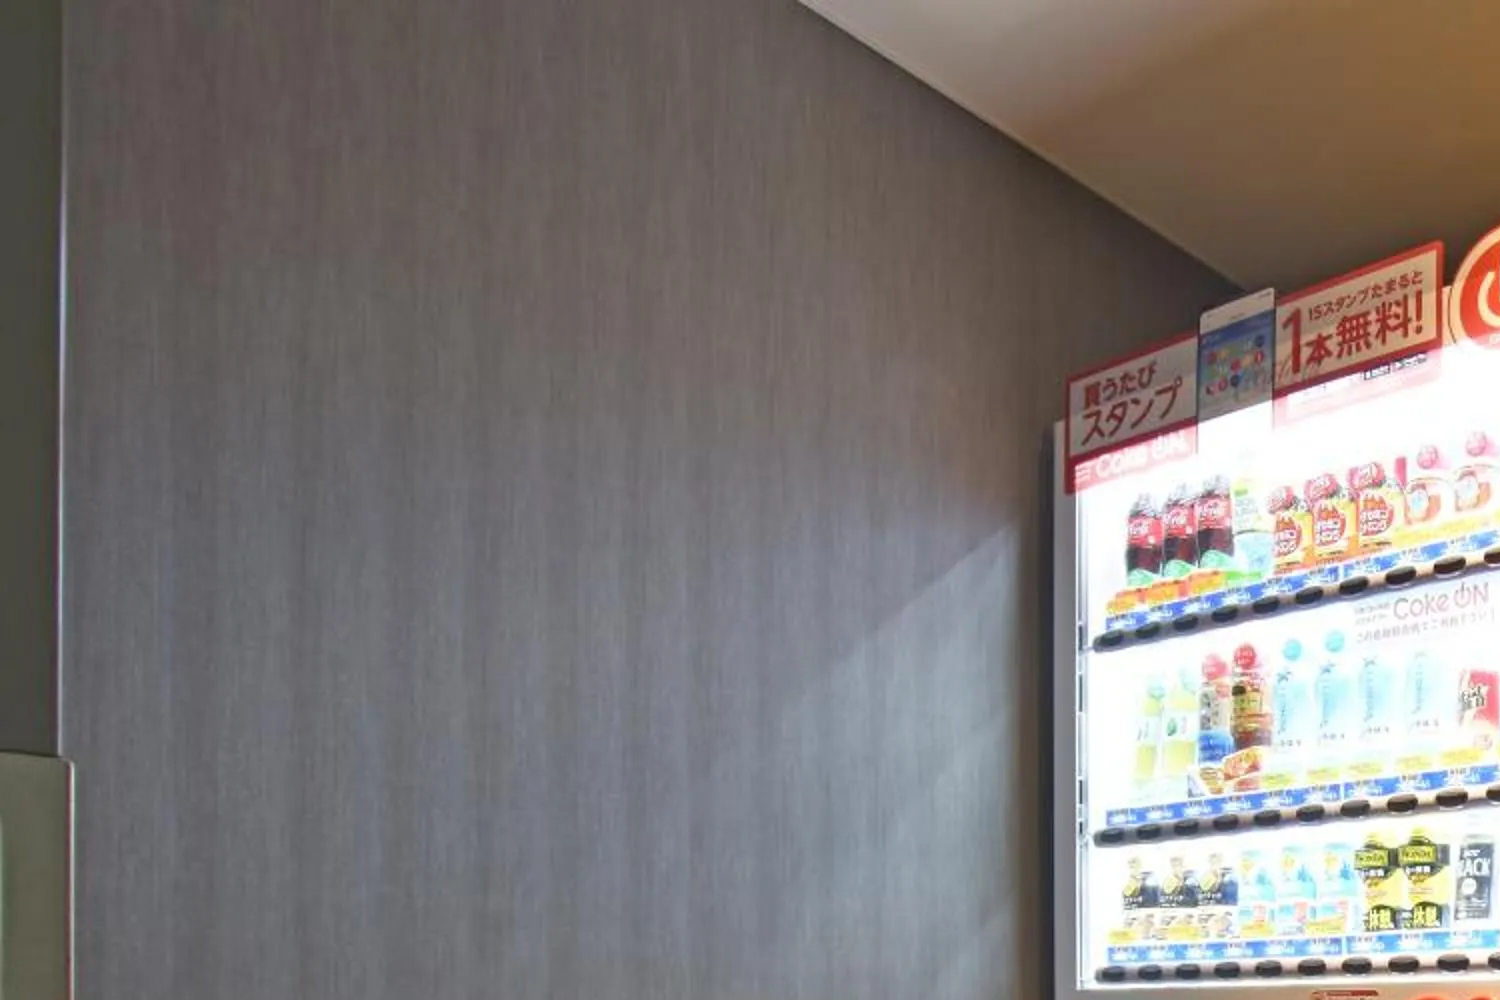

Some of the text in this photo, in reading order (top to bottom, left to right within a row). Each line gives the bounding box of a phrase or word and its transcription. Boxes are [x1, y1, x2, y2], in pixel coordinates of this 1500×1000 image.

[1281, 289, 1423, 375] 1本無料!
[1081, 375, 1183, 446] スタンプ
